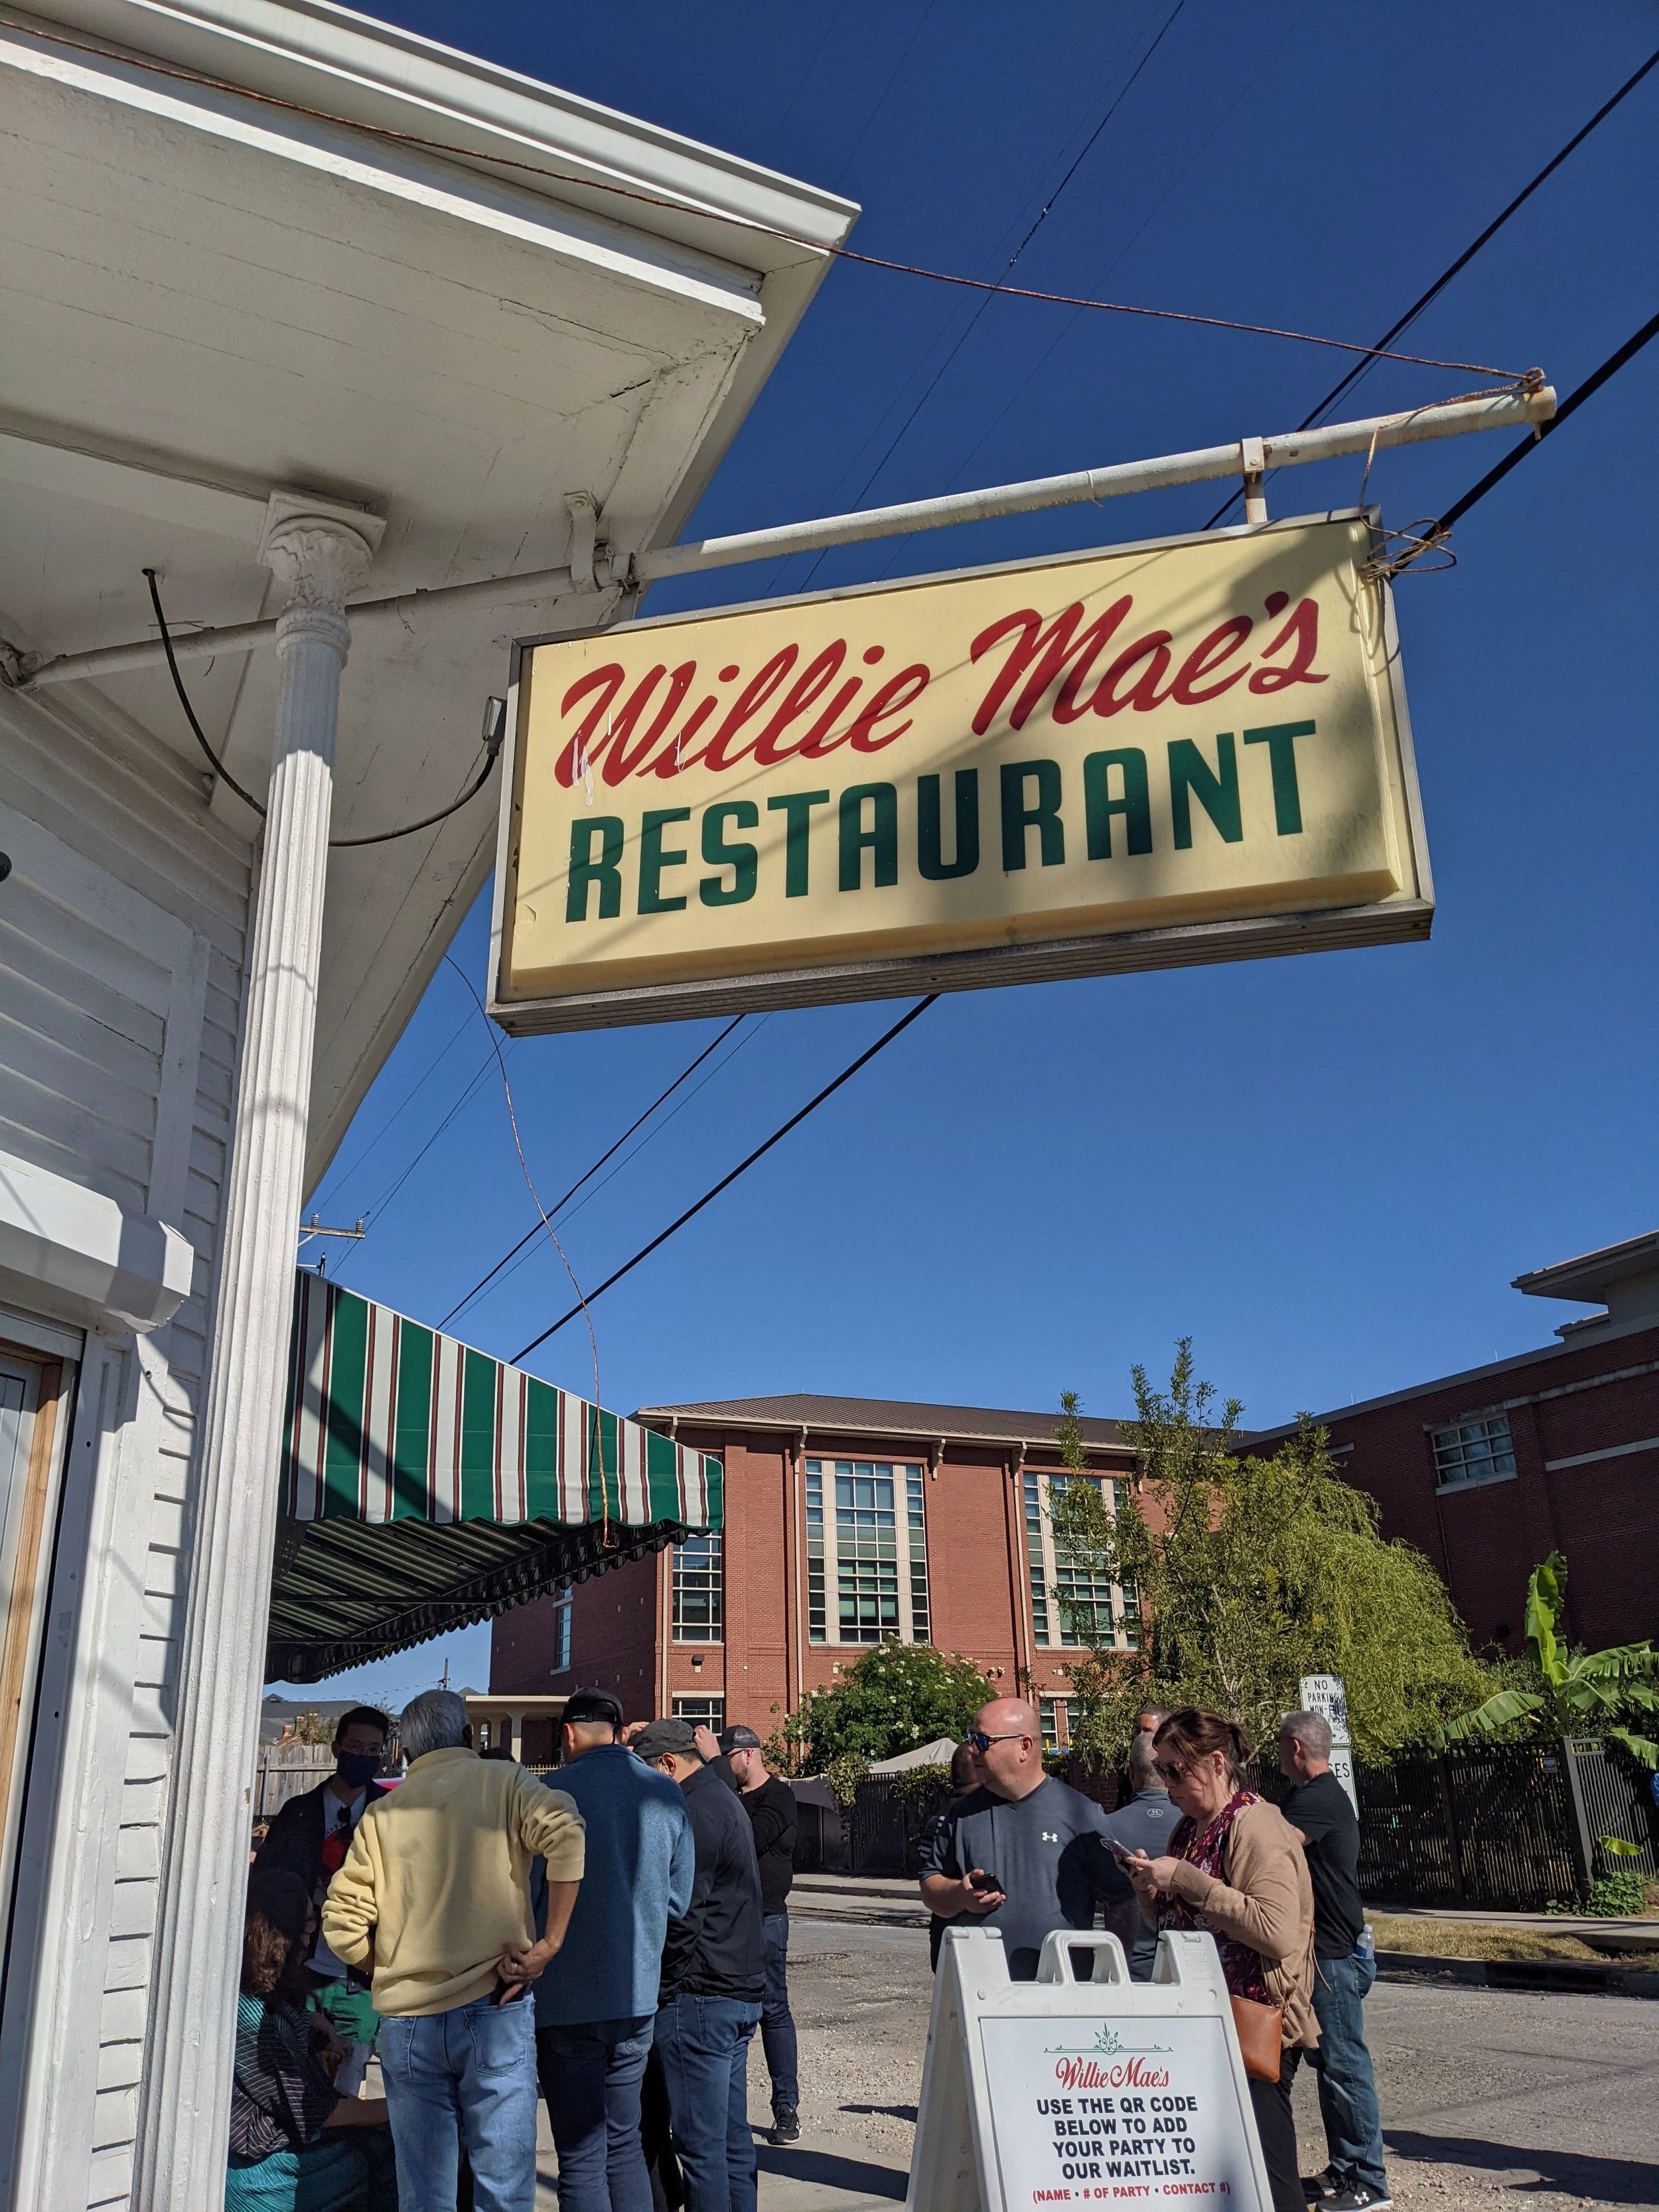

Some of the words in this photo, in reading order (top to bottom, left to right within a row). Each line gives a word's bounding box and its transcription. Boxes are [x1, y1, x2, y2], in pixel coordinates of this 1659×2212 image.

[554, 638, 930, 788] Willie
[970, 591, 1329, 736] Mae's
[566, 720, 1316, 922] RESTAURANT
[1314, 1680, 1328, 1690] NO
[1307, 1692, 1338, 1703] PARKING
[1055, 2056, 1109, 2091] Willie
[1110, 2057, 1169, 2088] Mae's
[1037, 2099, 1074, 2115] USE
[1078, 2098, 1115, 2114] THE
[1119, 2097, 1146, 2114] QR
[1150, 2096, 1198, 2112] CODE
[1054, 2118, 1116, 2136] BELOW
[1121, 2118, 1146, 2134] TO
[1153, 2117, 1187, 2133] ADD
[1052, 2140, 1104, 2158] YOUR
[1109, 2138, 1166, 2156] PARTY
[1171, 2137, 1196, 2154] TO
[1062, 2162, 1103, 2179] OUR
[1106, 2158, 1195, 2177] WAITLIST.
[1033, 2189, 1071, 2204] (NAME
[1094, 2187, 1109, 2199] OF
[1113, 2185, 1150, 2197] PARTY
[1163, 2182, 1216, 2195] CONTACT
